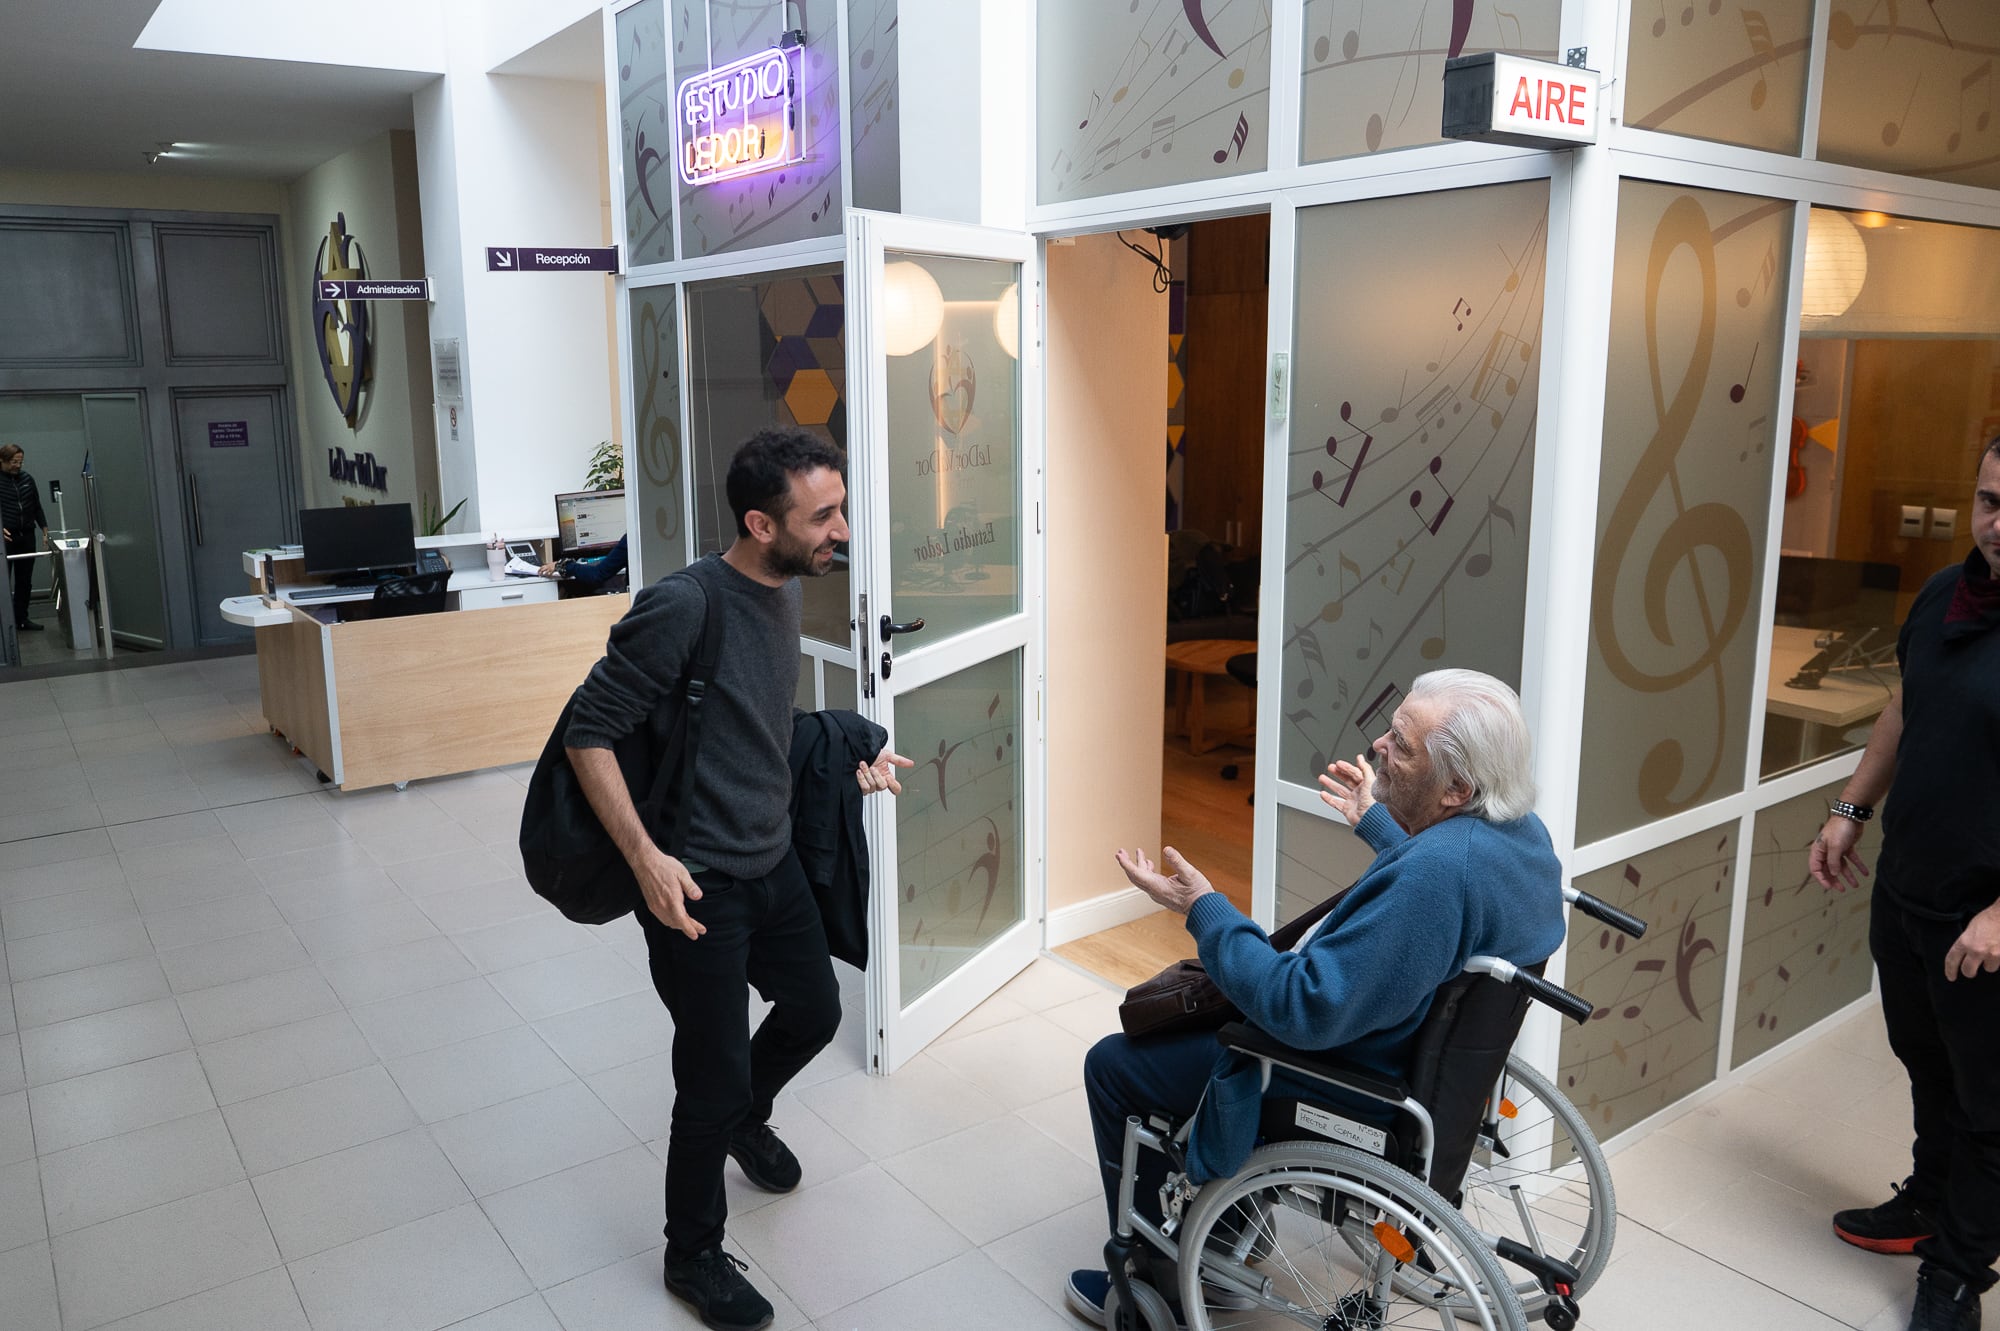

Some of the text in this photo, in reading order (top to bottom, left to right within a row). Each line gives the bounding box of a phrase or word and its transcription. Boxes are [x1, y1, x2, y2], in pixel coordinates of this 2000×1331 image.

[685, 58, 783, 126] ESTUDIO
[1509, 76, 1585, 125] AIRE
[685, 123, 761, 174] LEDOR
[535, 253, 590, 266] Recepción
[356, 285, 420, 295] Administración
